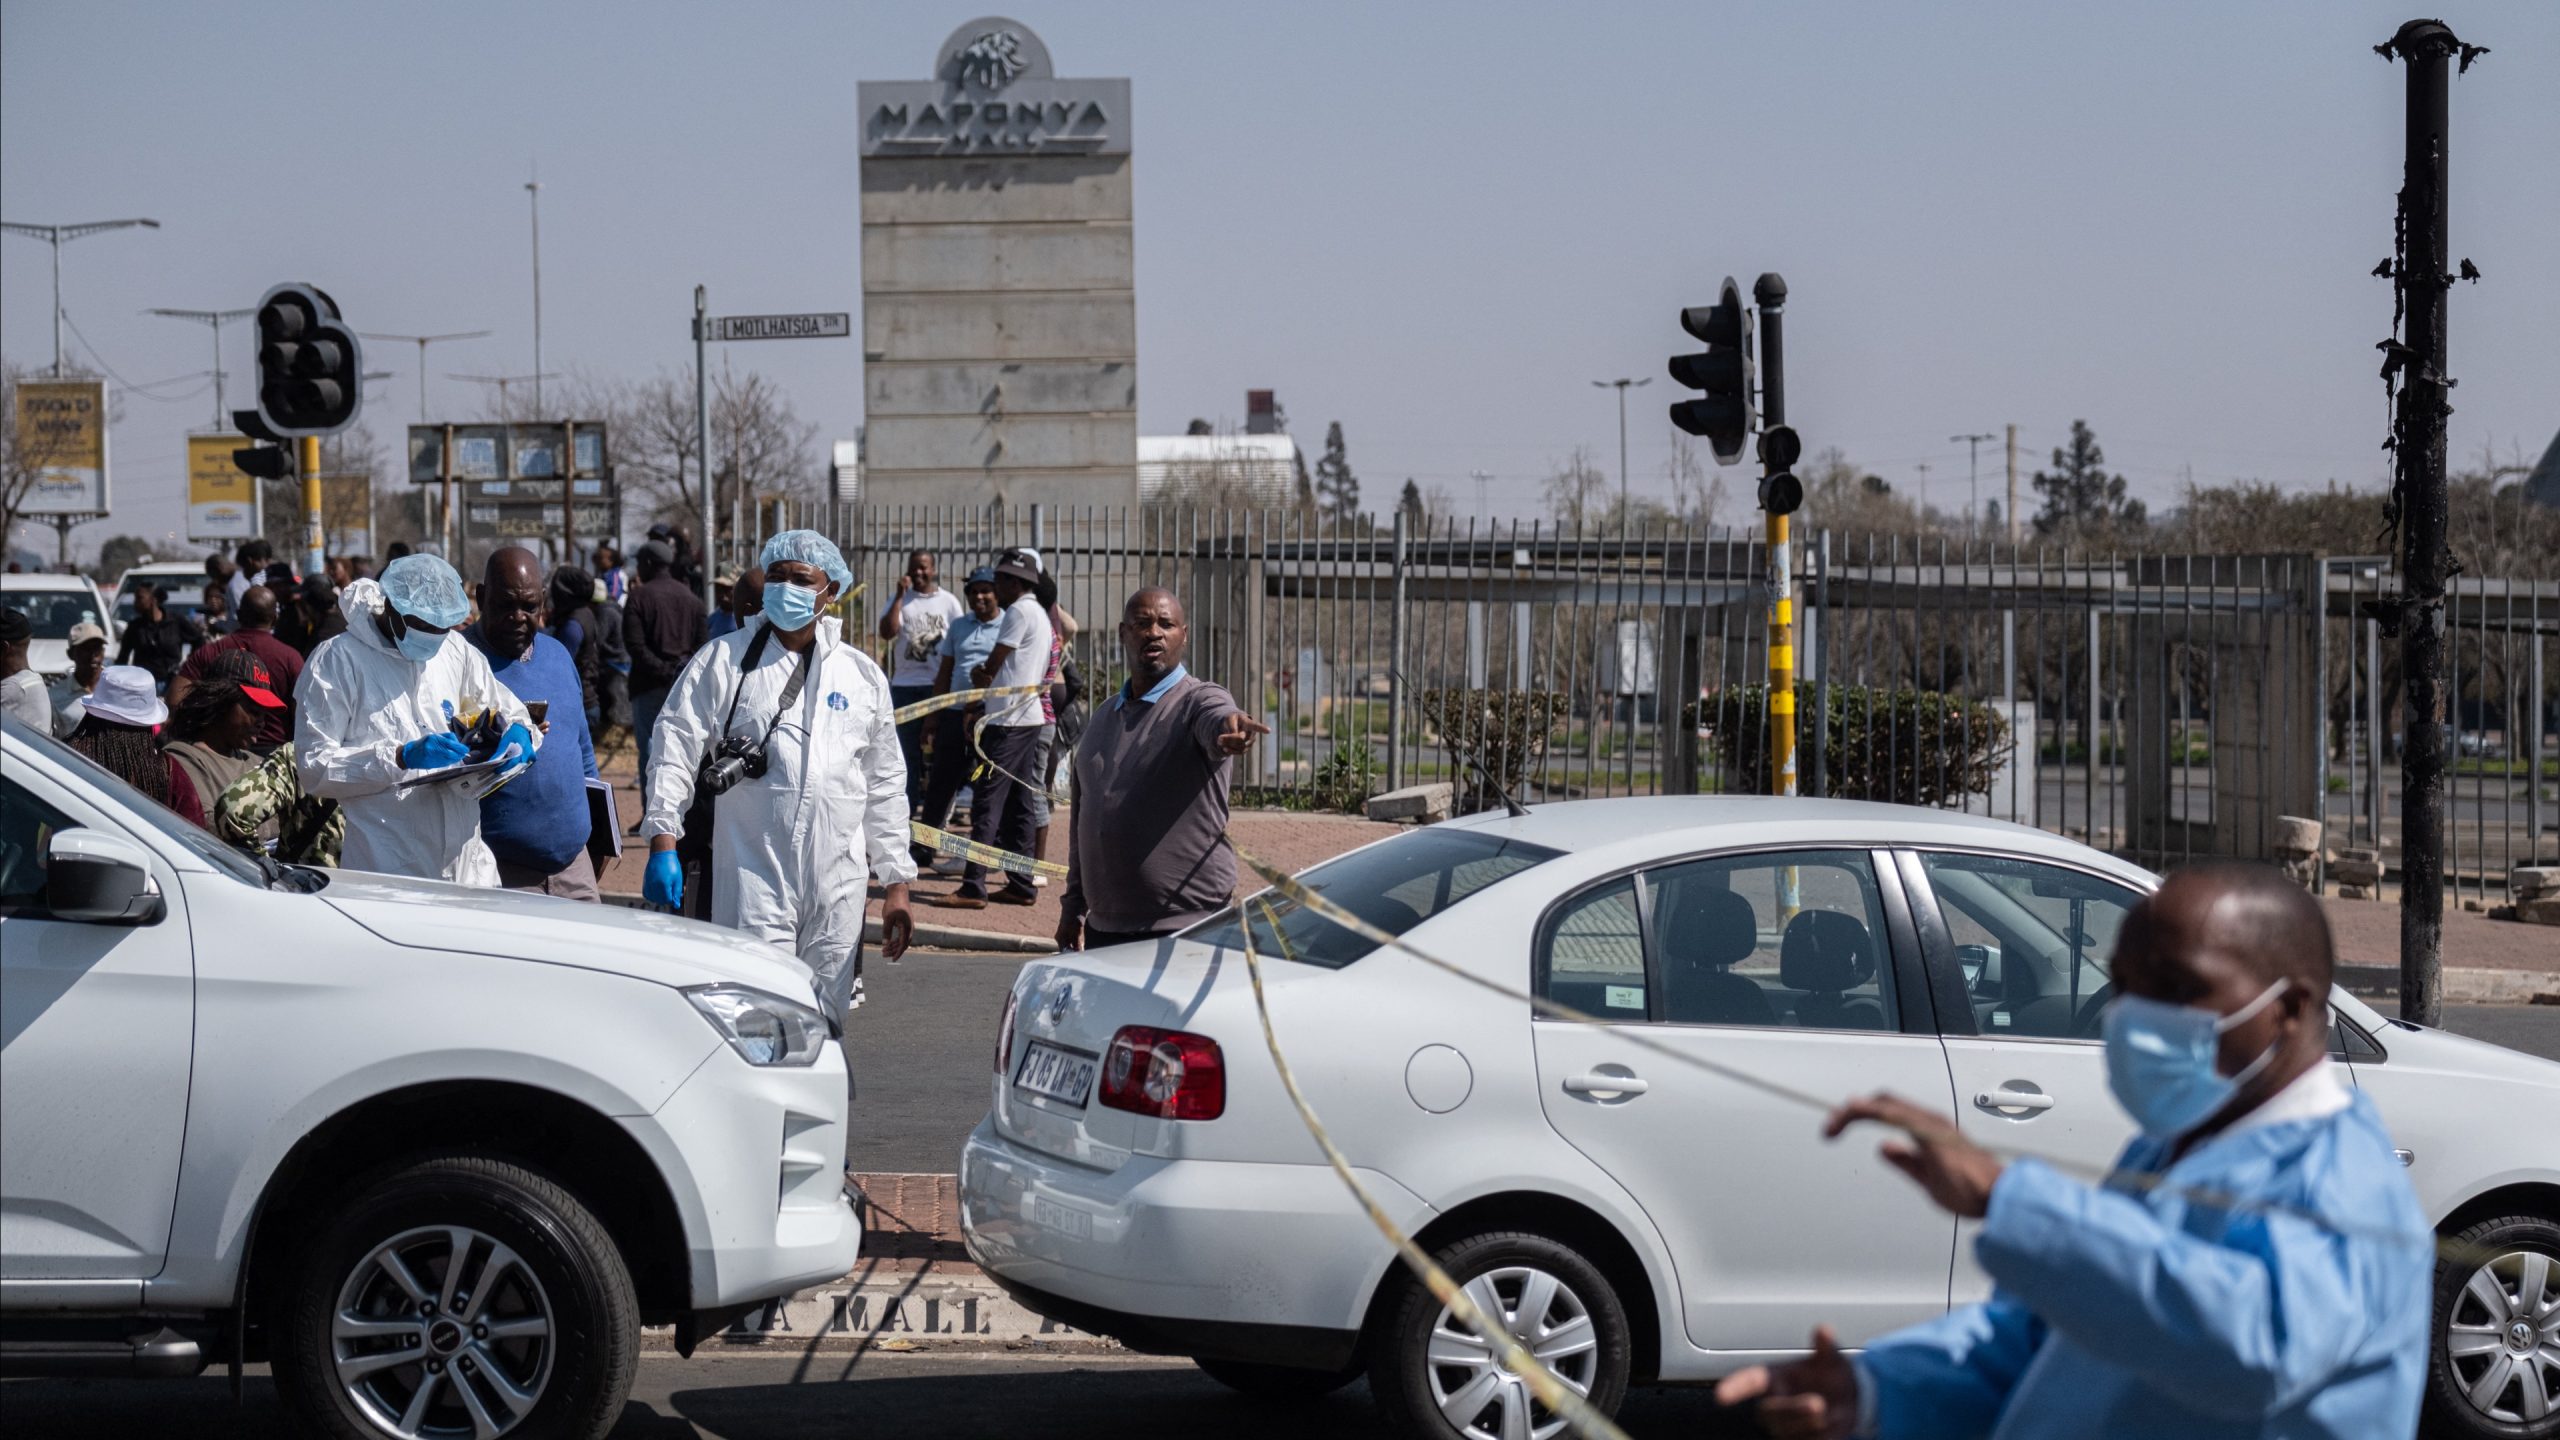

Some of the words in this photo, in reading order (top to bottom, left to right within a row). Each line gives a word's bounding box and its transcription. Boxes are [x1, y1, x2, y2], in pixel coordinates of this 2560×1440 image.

[880, 101, 1107, 125] MAPONYA
[733, 317, 820, 337] MOTLHATSOA
[1071, 1063, 1093, 1097] GP
[832, 1295, 991, 1334] MALL
